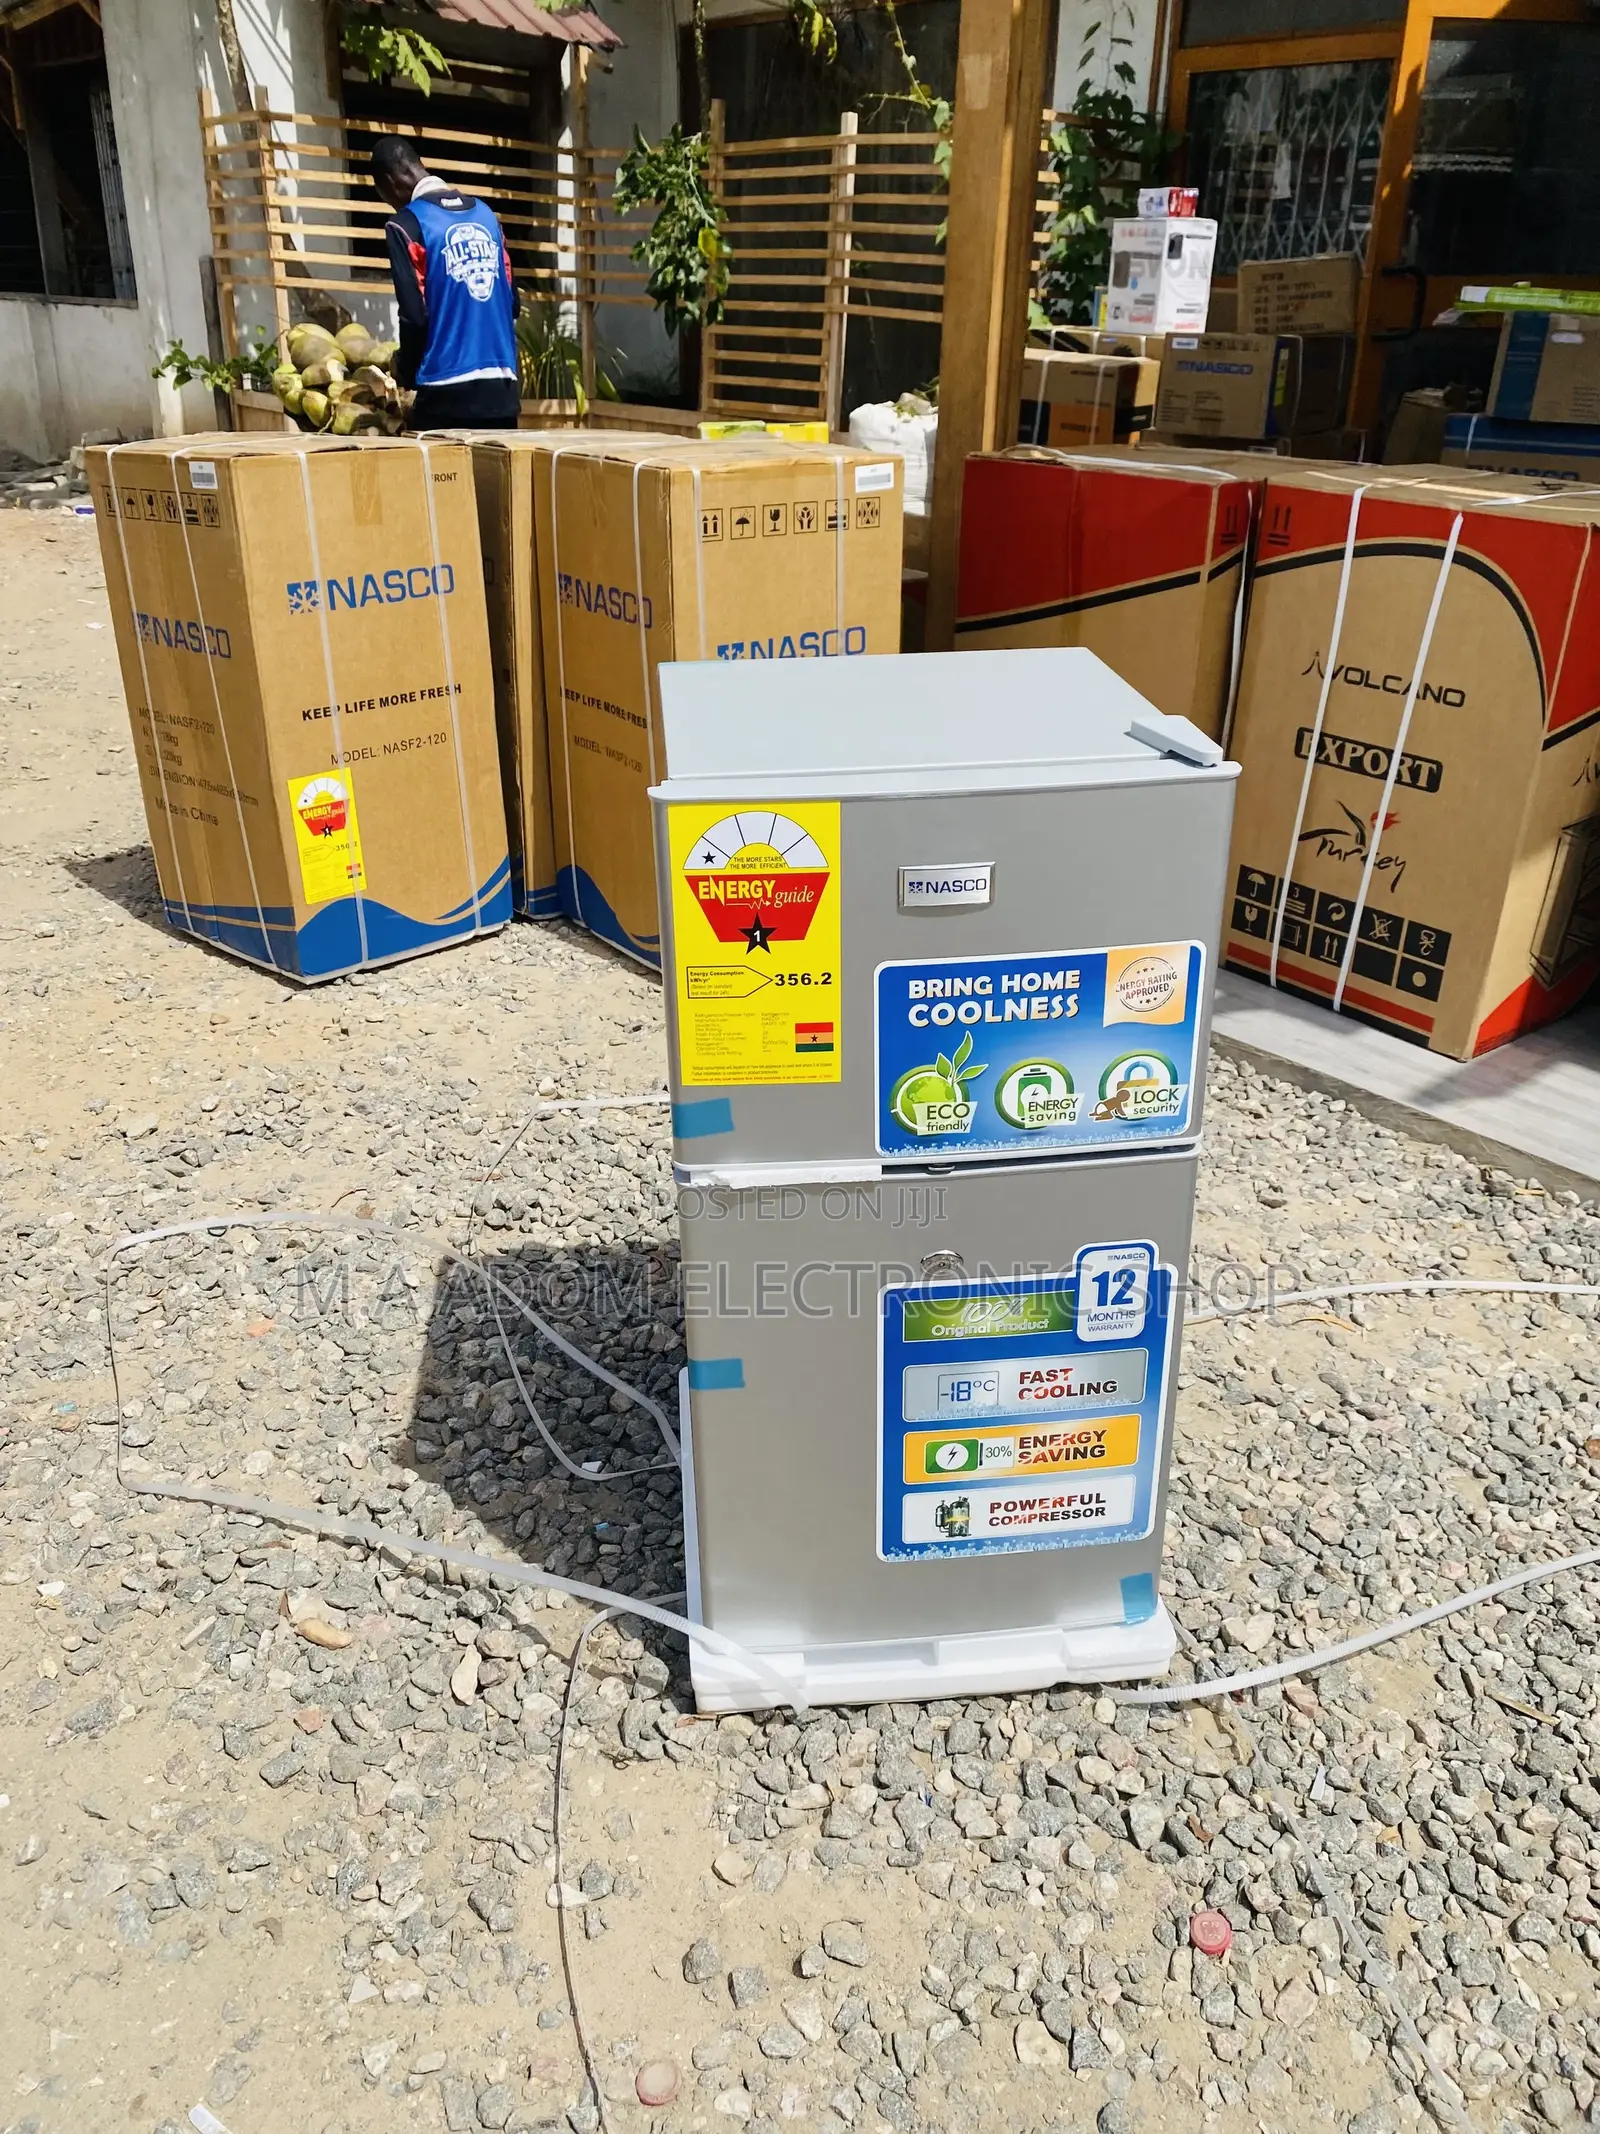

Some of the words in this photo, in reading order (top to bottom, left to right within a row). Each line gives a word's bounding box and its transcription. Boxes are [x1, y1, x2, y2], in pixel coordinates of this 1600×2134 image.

[327, 564, 455, 611] NASCO
[153, 616, 231, 659] NASCO
[750, 626, 866, 660] NASCO
[345, 699, 376, 714] LIFE
[379, 692, 417, 709] MORE
[582, 695, 602, 710] LIFE
[603, 702, 626, 721] MORE
[331, 746, 380, 766] MODEL:
[383, 732, 447, 755] NASF2-120
[302, 805, 332, 820] ENERGY
[698, 876, 776, 906] ENERGY
[774, 885, 815, 908] guide
[926, 879, 987, 893] NASCO
[753, 930, 761, 942] 1
[775, 972, 832, 987] 356.2
[908, 975, 993, 999] BRING
[1001, 970, 1081, 993] HOME
[1147, 971, 1178, 985] RATING
[1125, 983, 1170, 1000] APPROVED
[908, 994, 1080, 1027] COOLNESS
[1134, 1088, 1179, 1104] LOCK
[926, 1103, 970, 1120] ECO
[1028, 1098, 1079, 1112] ENERGY
[1133, 1102, 1180, 1115] security
[1028, 1110, 1077, 1122] saving
[926, 1119, 970, 1132] friendly
[1113, 1252, 1147, 1261] NASCO
[1091, 1268, 1136, 1307] 12
[1087, 1310, 1136, 1323] MONTHS
[931, 1321, 991, 1337] Original
[995, 1319, 1049, 1333] Product
[1088, 1322, 1134, 1332] WARRANTY
[1019, 1368, 1073, 1384] FAST
[1018, 1380, 1117, 1402] COOLING
[985, 1445, 1012, 1459] 30%
[1018, 1430, 1107, 1449] ENERGY
[1018, 1445, 1106, 1464] SAVING
[989, 1492, 1106, 1513] POWERFUL
[988, 1506, 1106, 1527] COMPRESSOR
